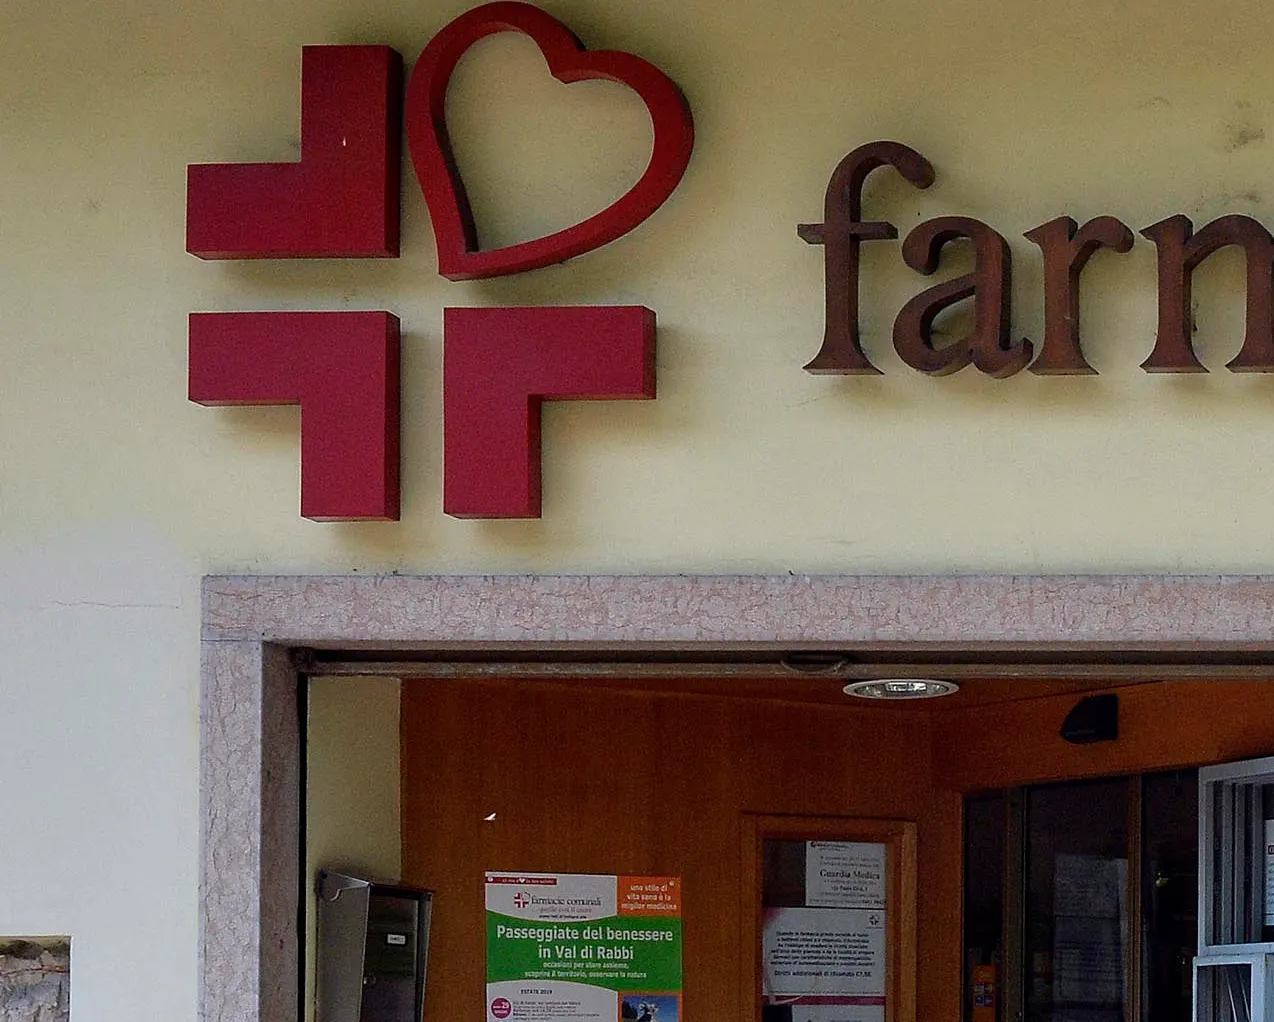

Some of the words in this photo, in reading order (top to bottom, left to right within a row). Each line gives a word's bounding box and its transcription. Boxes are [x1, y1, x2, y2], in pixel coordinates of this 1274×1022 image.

[497, 925, 580, 942] Passeggiate
[583, 926, 602, 940] del
[607, 927, 673, 941] benessere
[538, 945, 551, 958] in
[555, 945, 576, 959] Val
[581, 946, 593, 959] di
[597, 946, 633, 960] Rabbi
